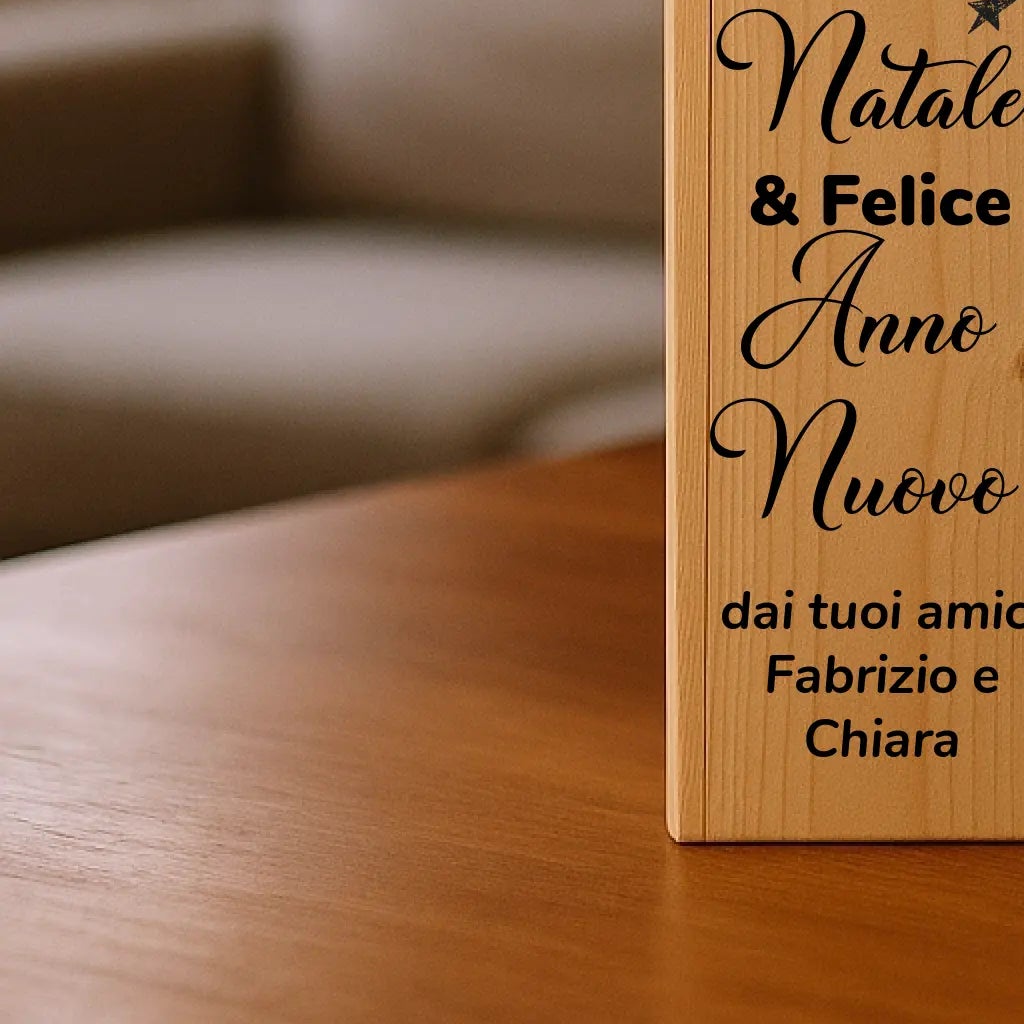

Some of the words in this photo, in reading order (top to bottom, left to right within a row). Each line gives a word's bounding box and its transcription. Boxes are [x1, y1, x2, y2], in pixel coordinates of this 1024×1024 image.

[750, 174, 800, 227] &
[822, 171, 1011, 227] Felice
[740, 229, 998, 370] Anno
[710, 397, 1019, 532] Nuovo
[721, 589, 793, 630] dai
[808, 589, 901, 630] tuoi
[766, 653, 958, 694] Fabrizio
[973, 665, 999, 694] e
[805, 717, 959, 758] Chiara
